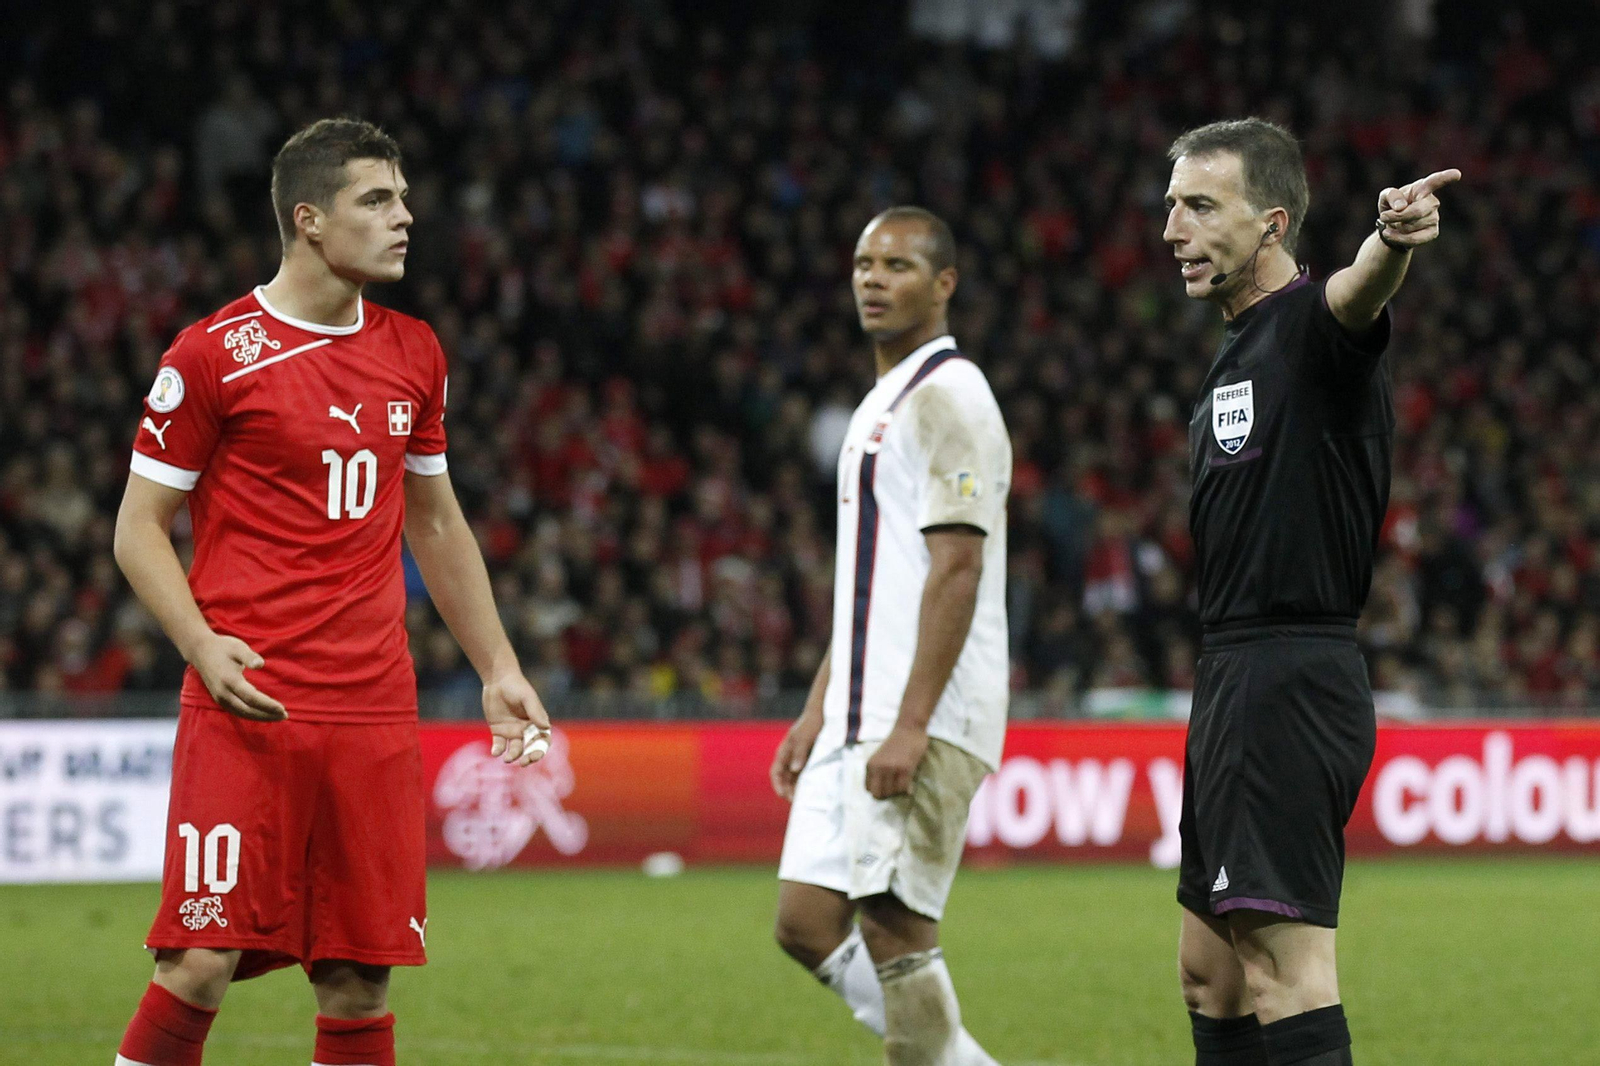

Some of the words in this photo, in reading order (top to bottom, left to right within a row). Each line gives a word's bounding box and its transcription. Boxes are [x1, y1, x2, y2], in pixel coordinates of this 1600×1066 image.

[1218, 408, 1247, 427] FIFA
[1225, 439, 1240, 448] 2012
[321, 449, 378, 520] 10
[1372, 731, 1600, 845] colou
[178, 822, 241, 893] 10
